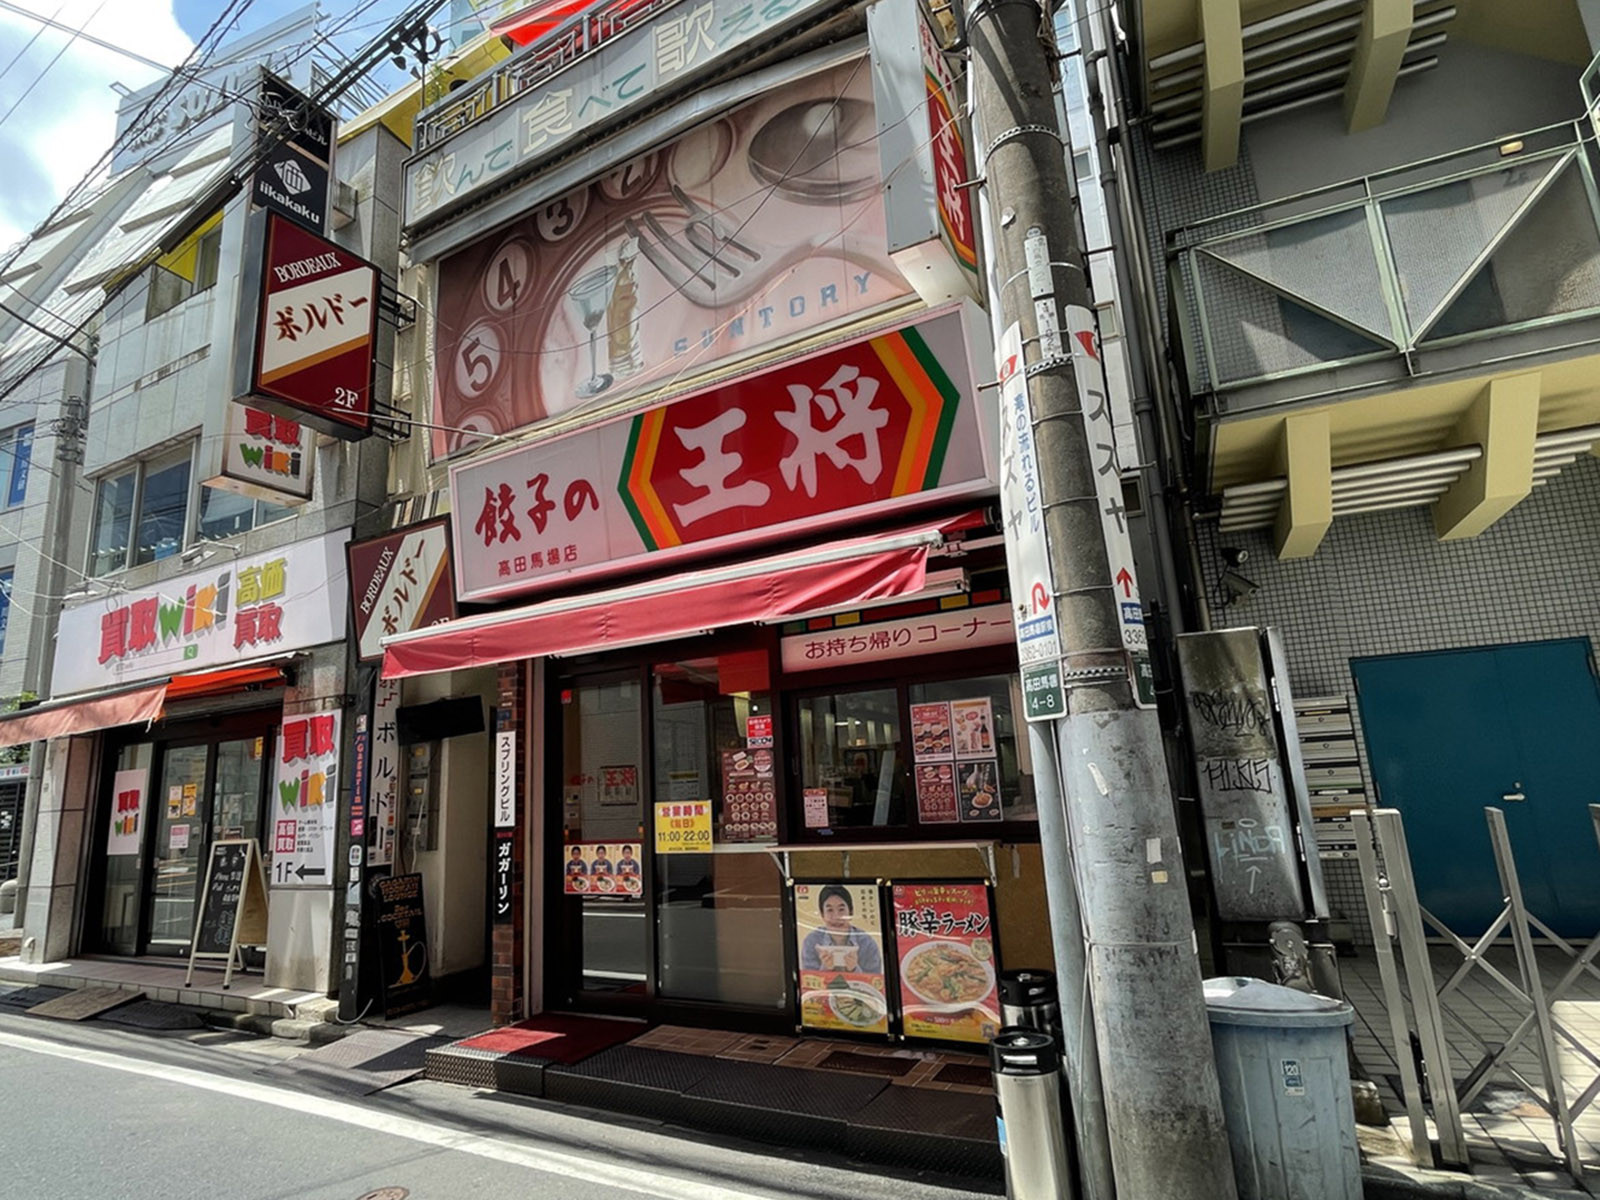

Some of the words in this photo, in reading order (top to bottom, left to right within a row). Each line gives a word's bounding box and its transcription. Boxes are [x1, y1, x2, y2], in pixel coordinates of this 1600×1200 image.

[259, 181, 320, 224] iikakaku
[274, 252, 341, 283] BORDEAUX
[499, 258, 522, 304] 4
[272, 293, 369, 342] ボルドー
[673, 271, 872, 358] SUNTORY
[460, 336, 495, 393] 5
[334, 386, 359, 408] 2F
[240, 443, 302, 477] wiki
[671, 364, 890, 528] 王将
[475, 473, 600, 547] 餃子の
[236, 557, 288, 609] 高価
[360, 546, 394, 615] BORDEAUX
[498, 544, 578, 577] 高田馬場店
[382, 539, 425, 635] ボルドー
[234, 602, 284, 650] 買取
[804, 617, 1012, 660] お持ち帰りコーナー
[1031, 694, 1055, 710] 4-8
[282, 714, 336, 764] 買取
[279, 763, 337, 812] wiki
[374, 721, 396, 851] ボルドー
[499, 736, 511, 823] スプリングビル
[276, 861, 293, 883] 1F
[497, 841, 511, 914] ガガーリン
[897, 908, 989, 939] 豚辛ラーメン
